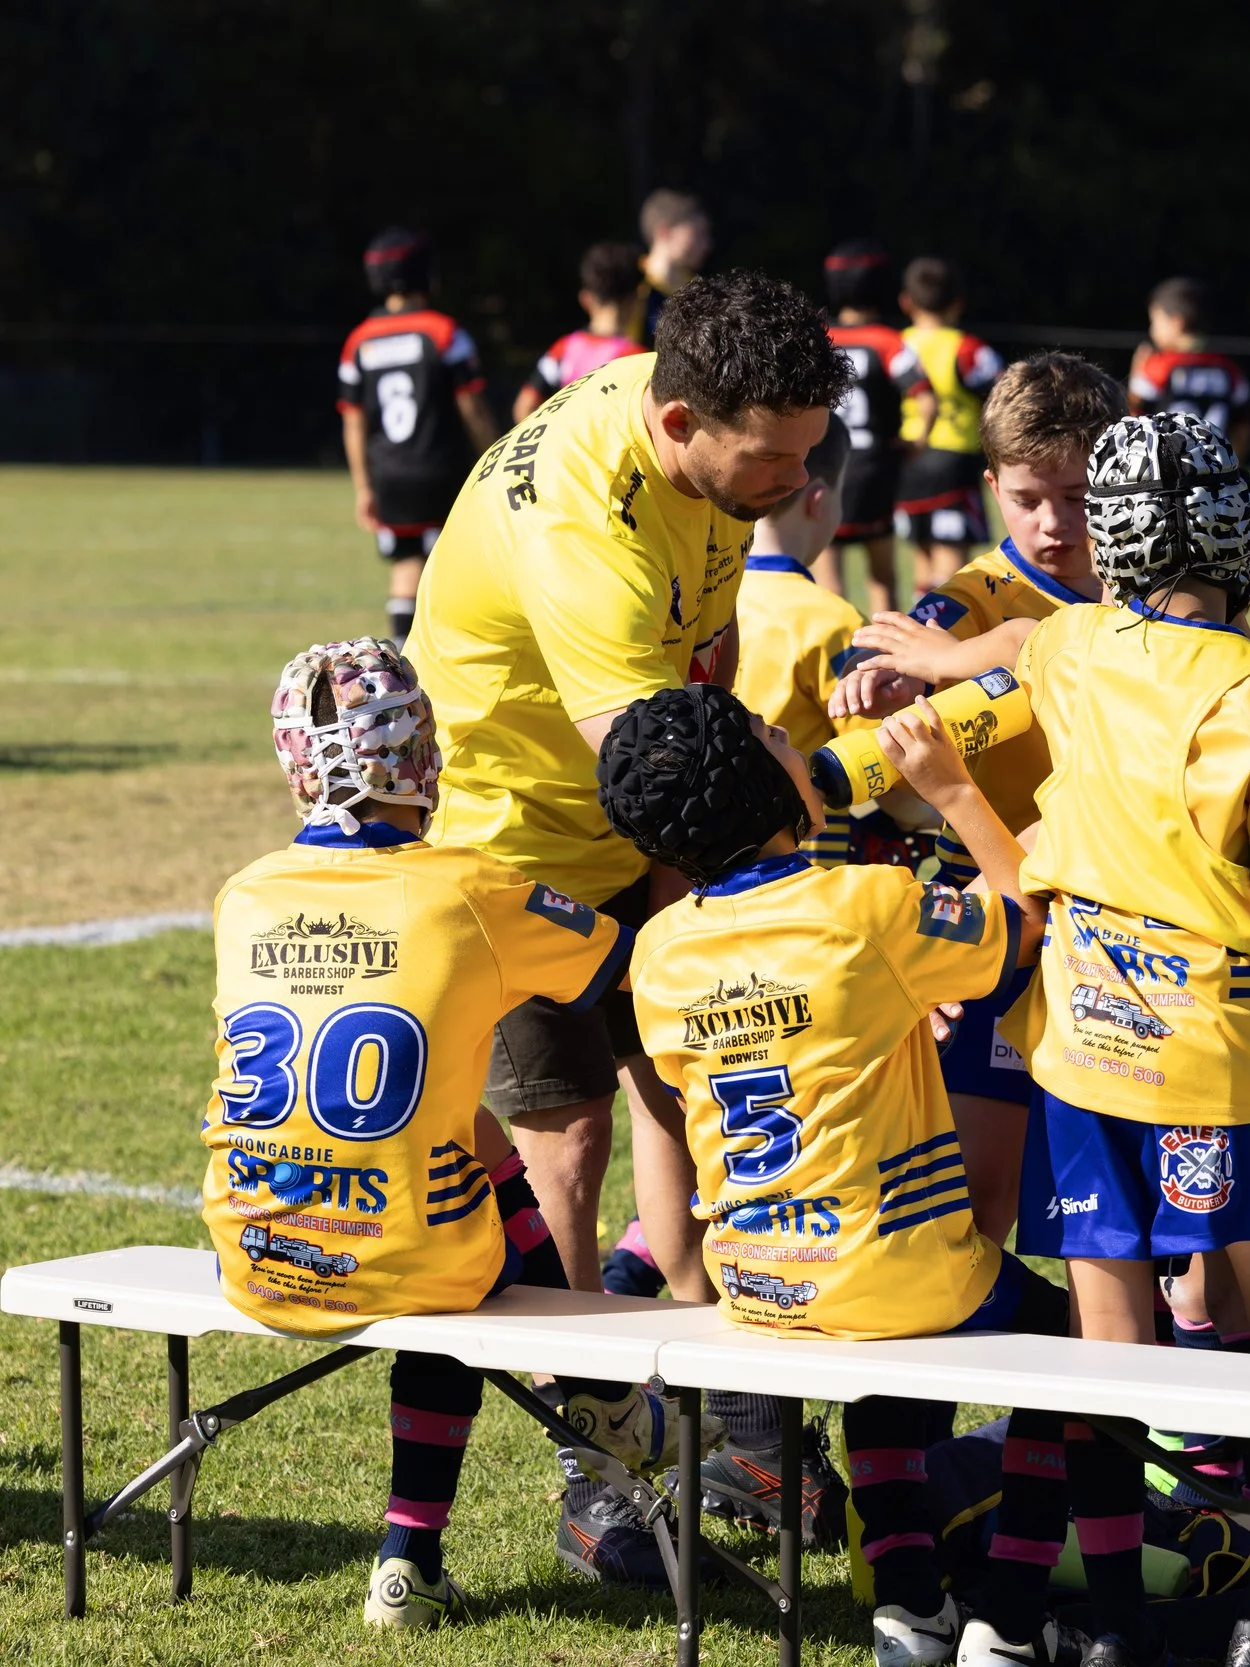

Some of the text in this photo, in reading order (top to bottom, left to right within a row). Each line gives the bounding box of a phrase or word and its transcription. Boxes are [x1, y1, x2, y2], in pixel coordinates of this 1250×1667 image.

[503, 423, 547, 511] SAFE
[250, 941, 398, 969] EXCLUSIVE
[283, 967, 356, 979] BARBER SHOP
[1063, 955, 1076, 969] ST
[1145, 994, 1195, 1007] PUMPING
[290, 985, 345, 995] NORWEST
[683, 993, 813, 1043] EXCLUSIVE
[712, 1029, 775, 1050] BARBER SHOP
[1073, 1024, 1160, 1054] You've never been pumped
[1082, 1038, 1095, 1047] like
[1097, 1041, 1111, 1051] this
[1112, 1045, 1135, 1058] before
[721, 1049, 768, 1066] NORWEST
[1063, 1047, 1165, 1087] 0406 650 500
[219, 1001, 428, 1142] 30
[708, 1064, 803, 1186] 5
[1161, 1125, 1229, 1152] ELIE'S
[228, 1133, 334, 1162] TOONGABBIE
[228, 1148, 389, 1214] SPORTS
[1177, 1195, 1224, 1210] BUTCHERY
[229, 1196, 383, 1238] ST MARY'S CONCRETE PUMPING
[741, 1243, 788, 1262] CONCRETE
[789, 1247, 837, 1263] PUMPING
[250, 1263, 347, 1289] You've never been pumped
[267, 1276, 281, 1286] like
[283, 1279, 296, 1290] this
[298, 1281, 322, 1294] before
[77, 1300, 109, 1311] LIFETIME
[247, 1281, 358, 1313] 0406 650 500
[730, 1301, 807, 1321] You've never been pumped
